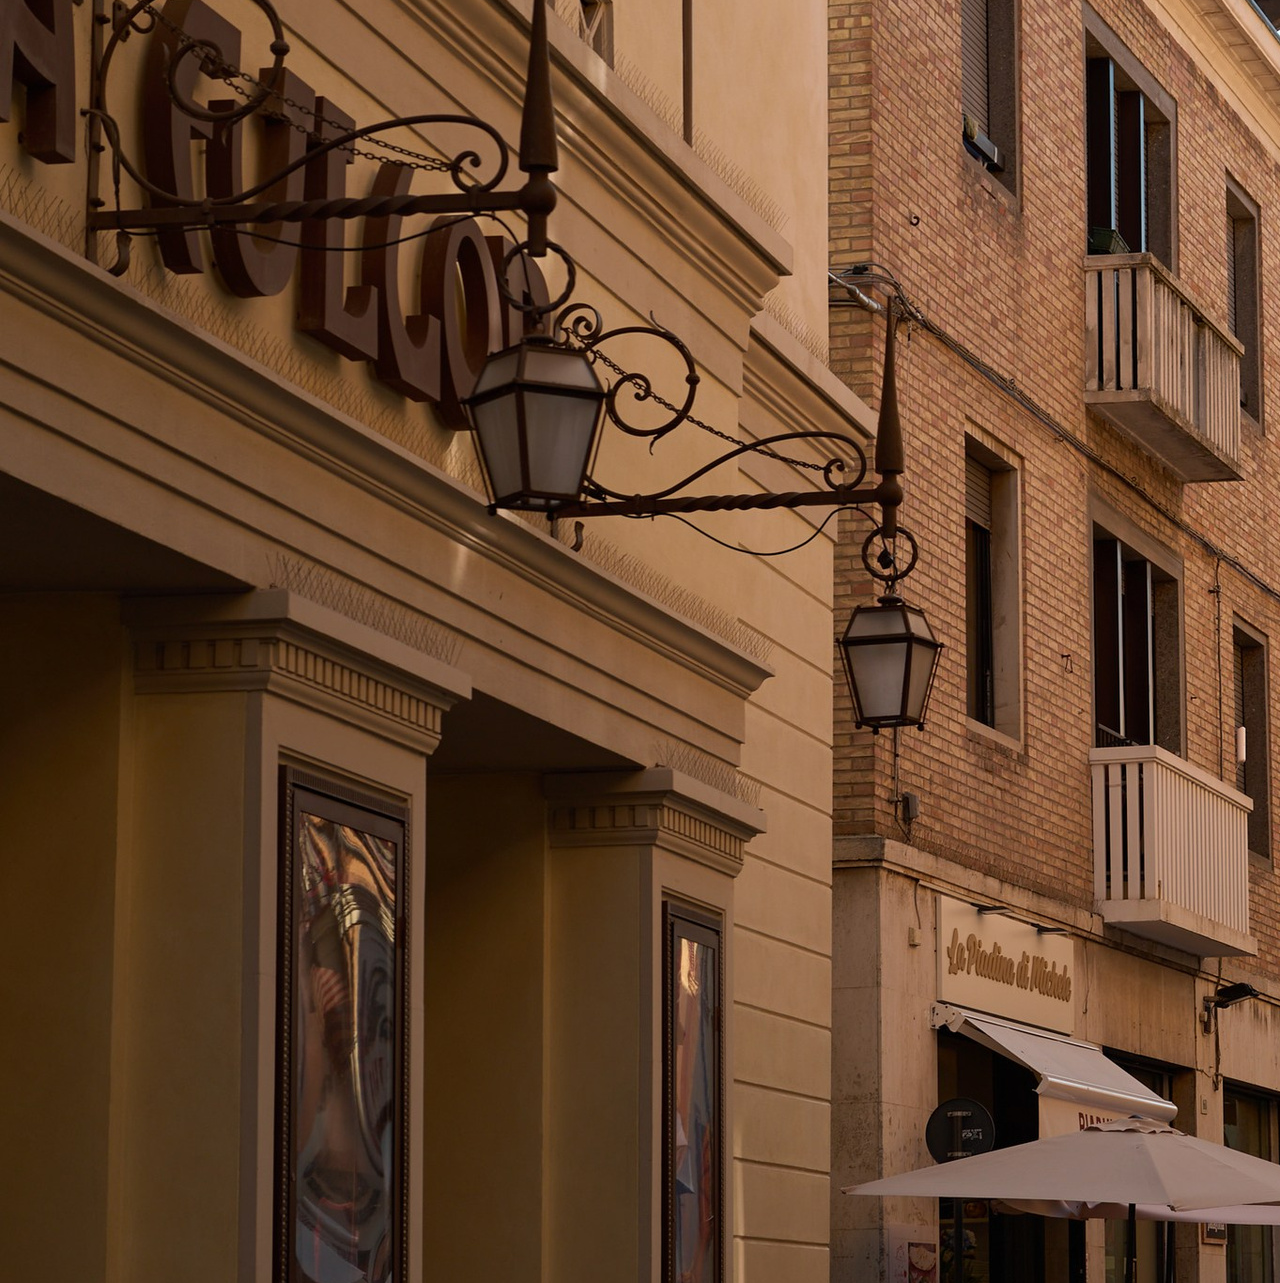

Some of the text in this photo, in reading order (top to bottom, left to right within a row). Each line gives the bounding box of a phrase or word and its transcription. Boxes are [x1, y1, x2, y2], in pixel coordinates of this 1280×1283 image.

[947, 927, 1072, 1002] La Piadina di Michele
